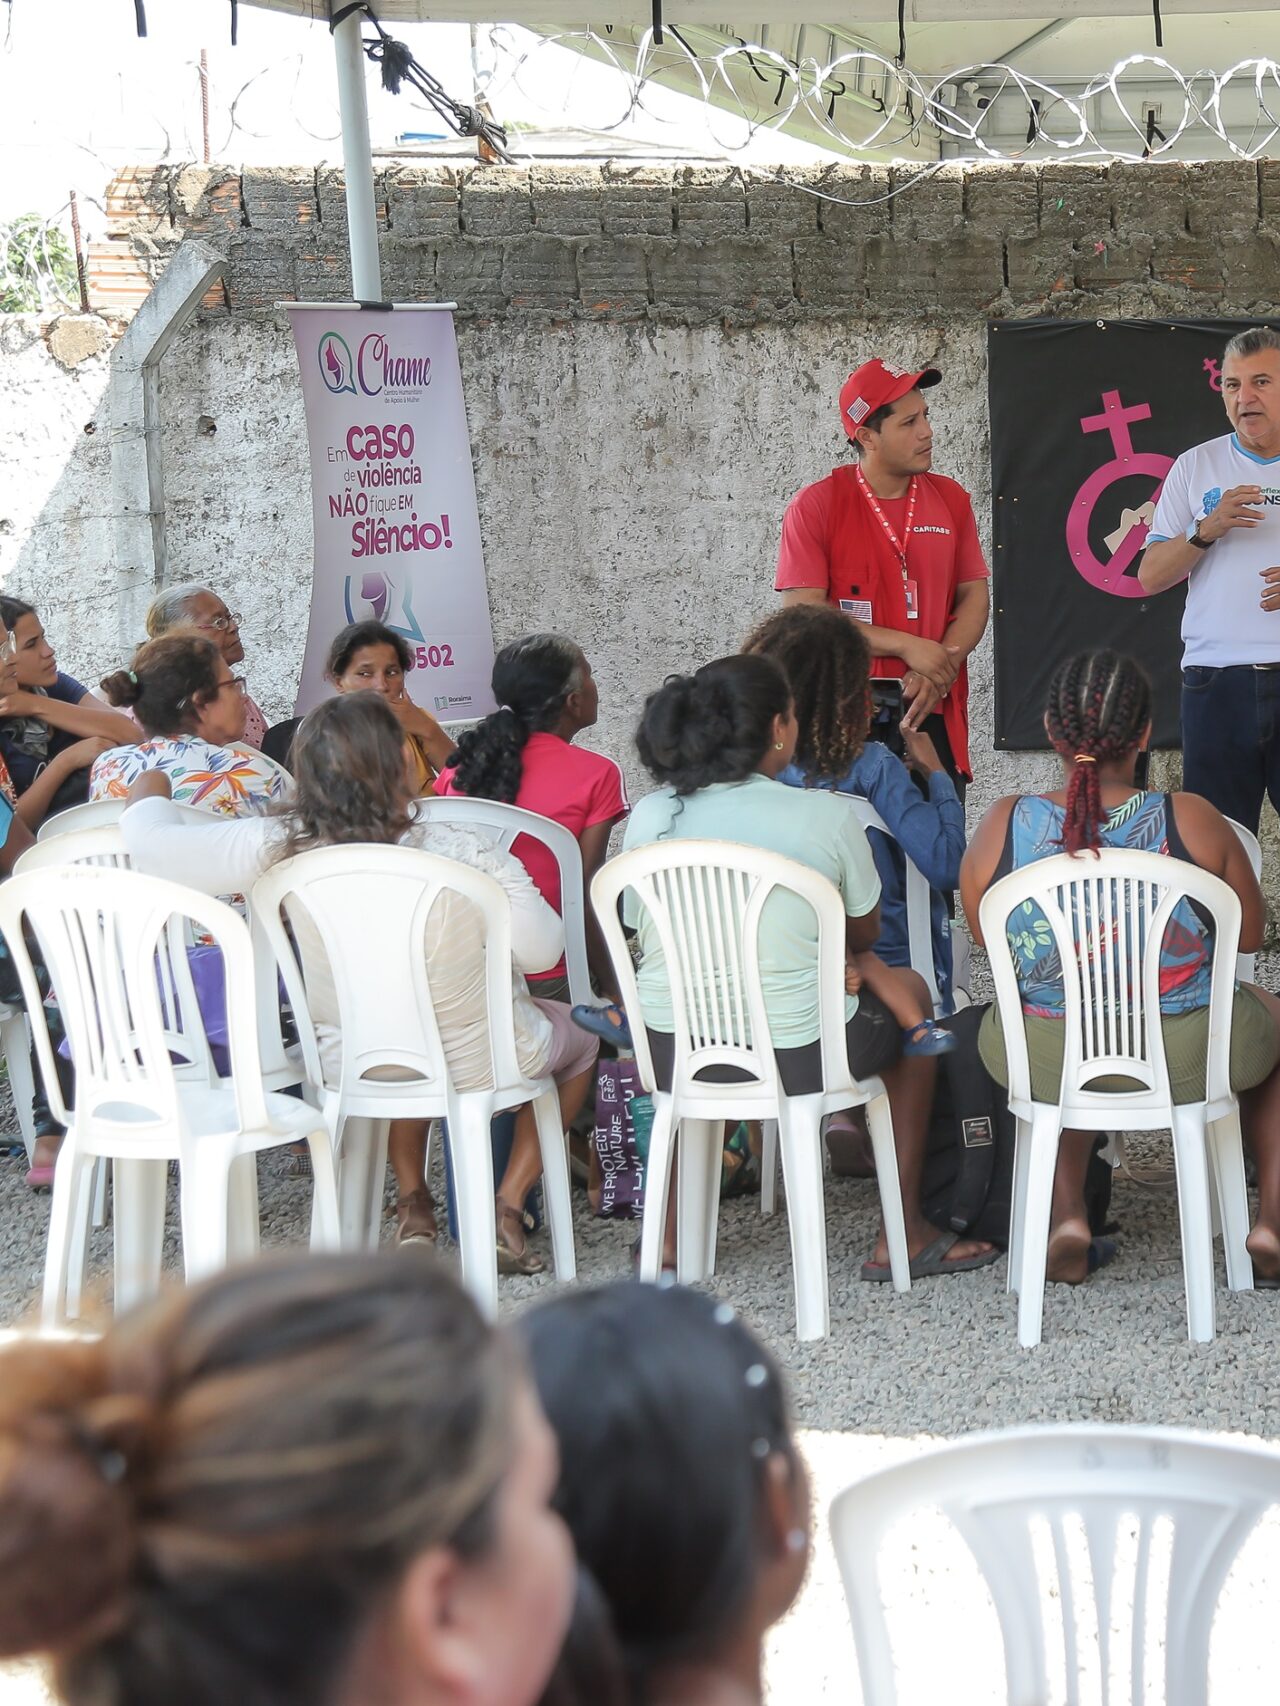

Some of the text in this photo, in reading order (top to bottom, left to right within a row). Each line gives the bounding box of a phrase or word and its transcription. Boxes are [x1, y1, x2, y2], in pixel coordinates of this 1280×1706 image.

[358, 333, 432, 396] Chame
[327, 424, 415, 462] Em caso
[344, 459, 422, 488] de violência
[328, 487, 413, 518] NÃO fique EM
[351, 512, 453, 558] Silêncio!
[913, 526, 945, 534] CARITAS
[595, 1125, 618, 1189] PROTECT
